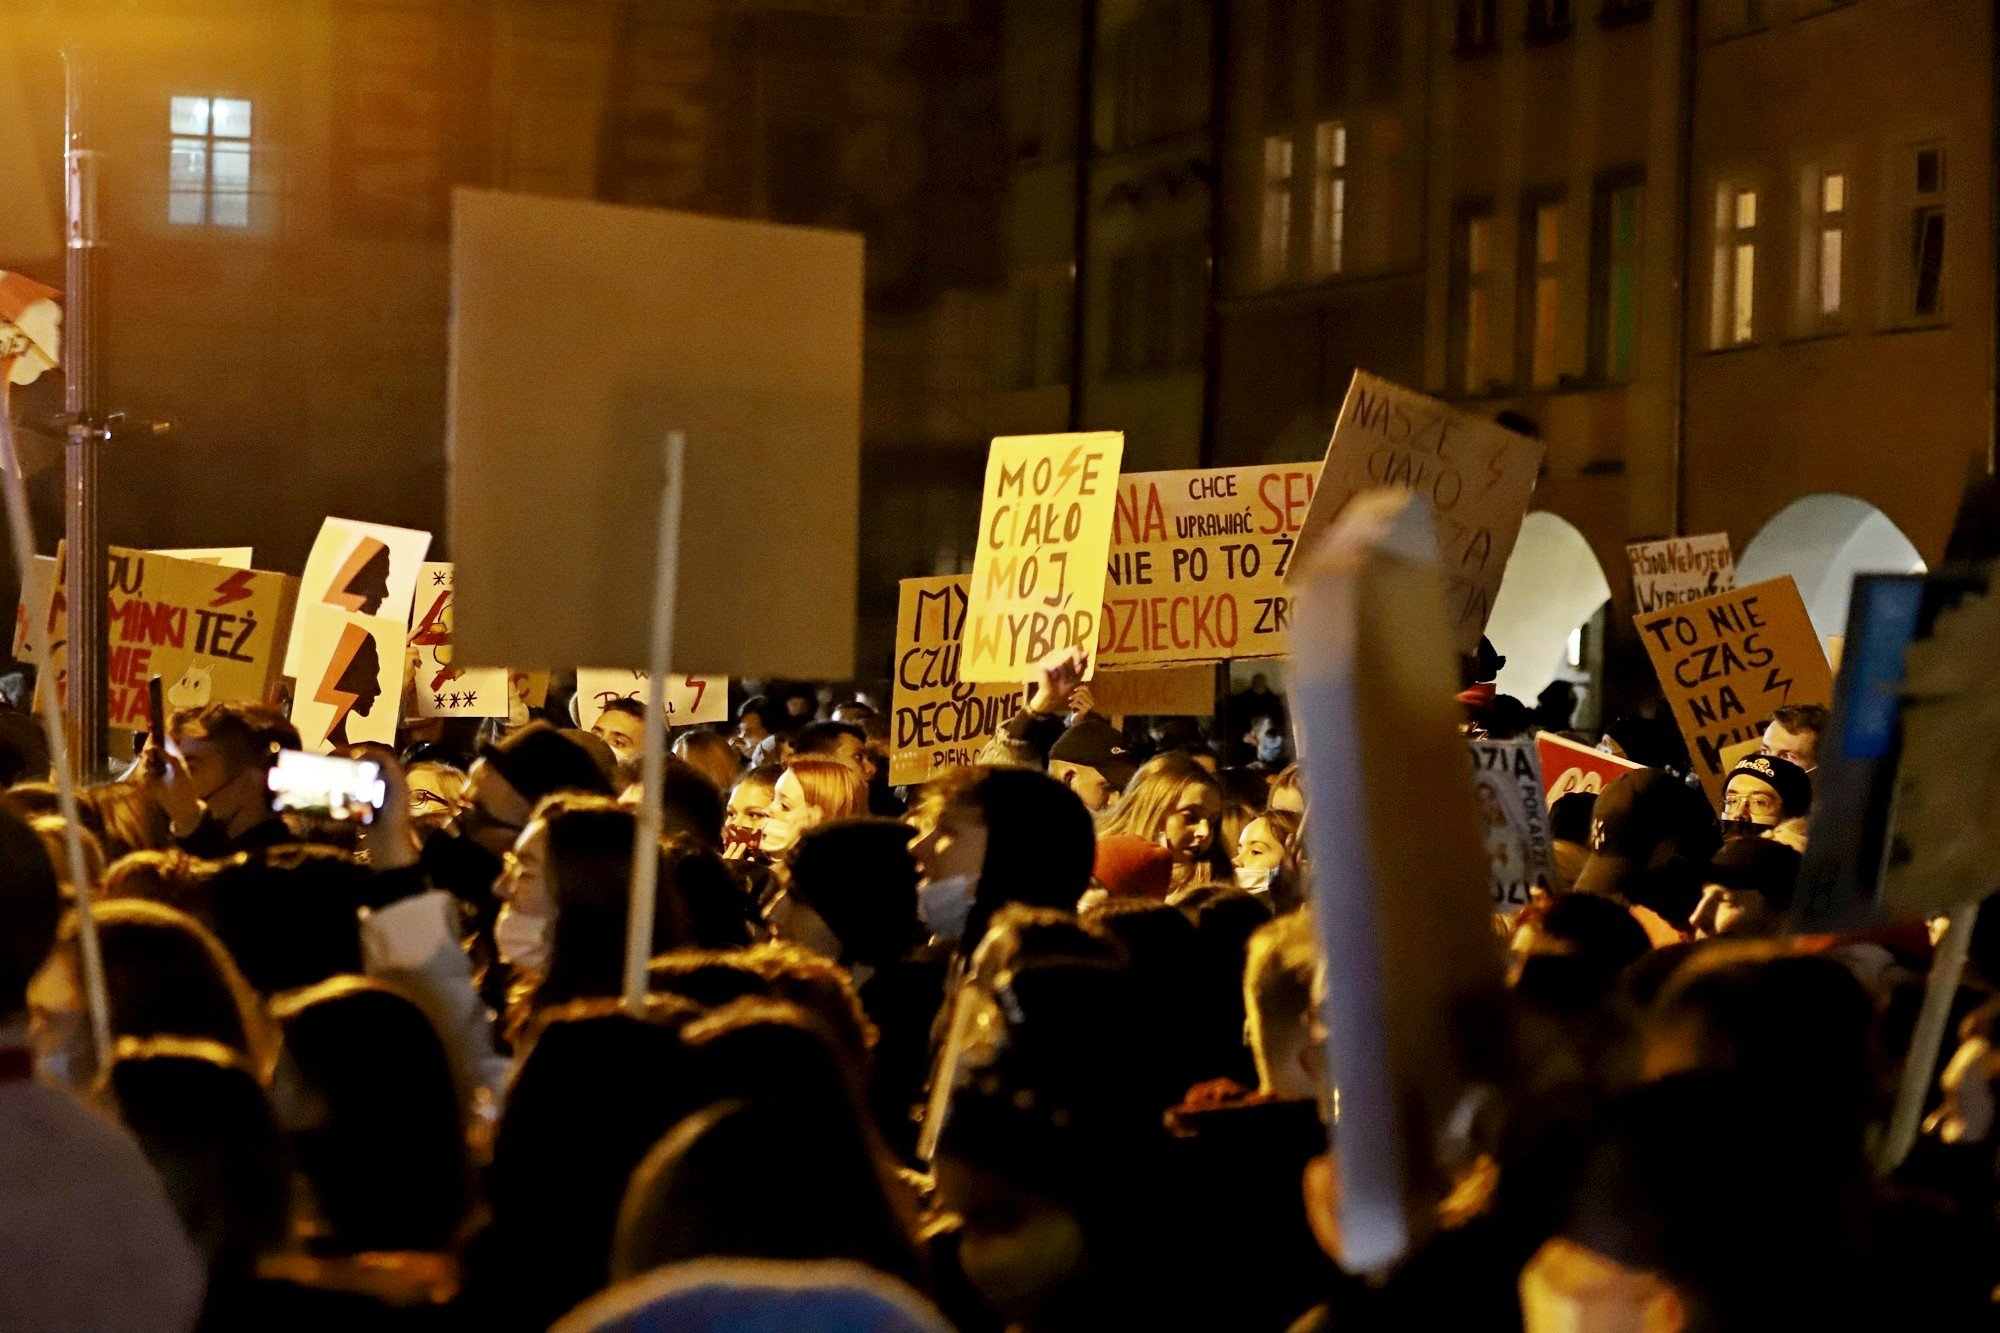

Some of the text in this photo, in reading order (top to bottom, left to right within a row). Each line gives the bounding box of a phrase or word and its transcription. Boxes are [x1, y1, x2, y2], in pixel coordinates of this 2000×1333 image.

[1188, 474, 1237, 500] CHCE
[989, 502, 1082, 550] CIAŁO
[1175, 506, 1254, 539] UPRAWIAĆ
[986, 546, 1068, 608] MÓJ
[1172, 547, 1208, 583] PO
[1219, 543, 1260, 580] TO
[194, 607, 258, 664] TEŻ
[970, 592, 1094, 668] WYBÓR
[1097, 592, 1238, 655] DZIECKO
[1644, 595, 1767, 652] TO NIE
[1674, 633, 1774, 688] CZAS
[1688, 684, 1746, 728] NA
